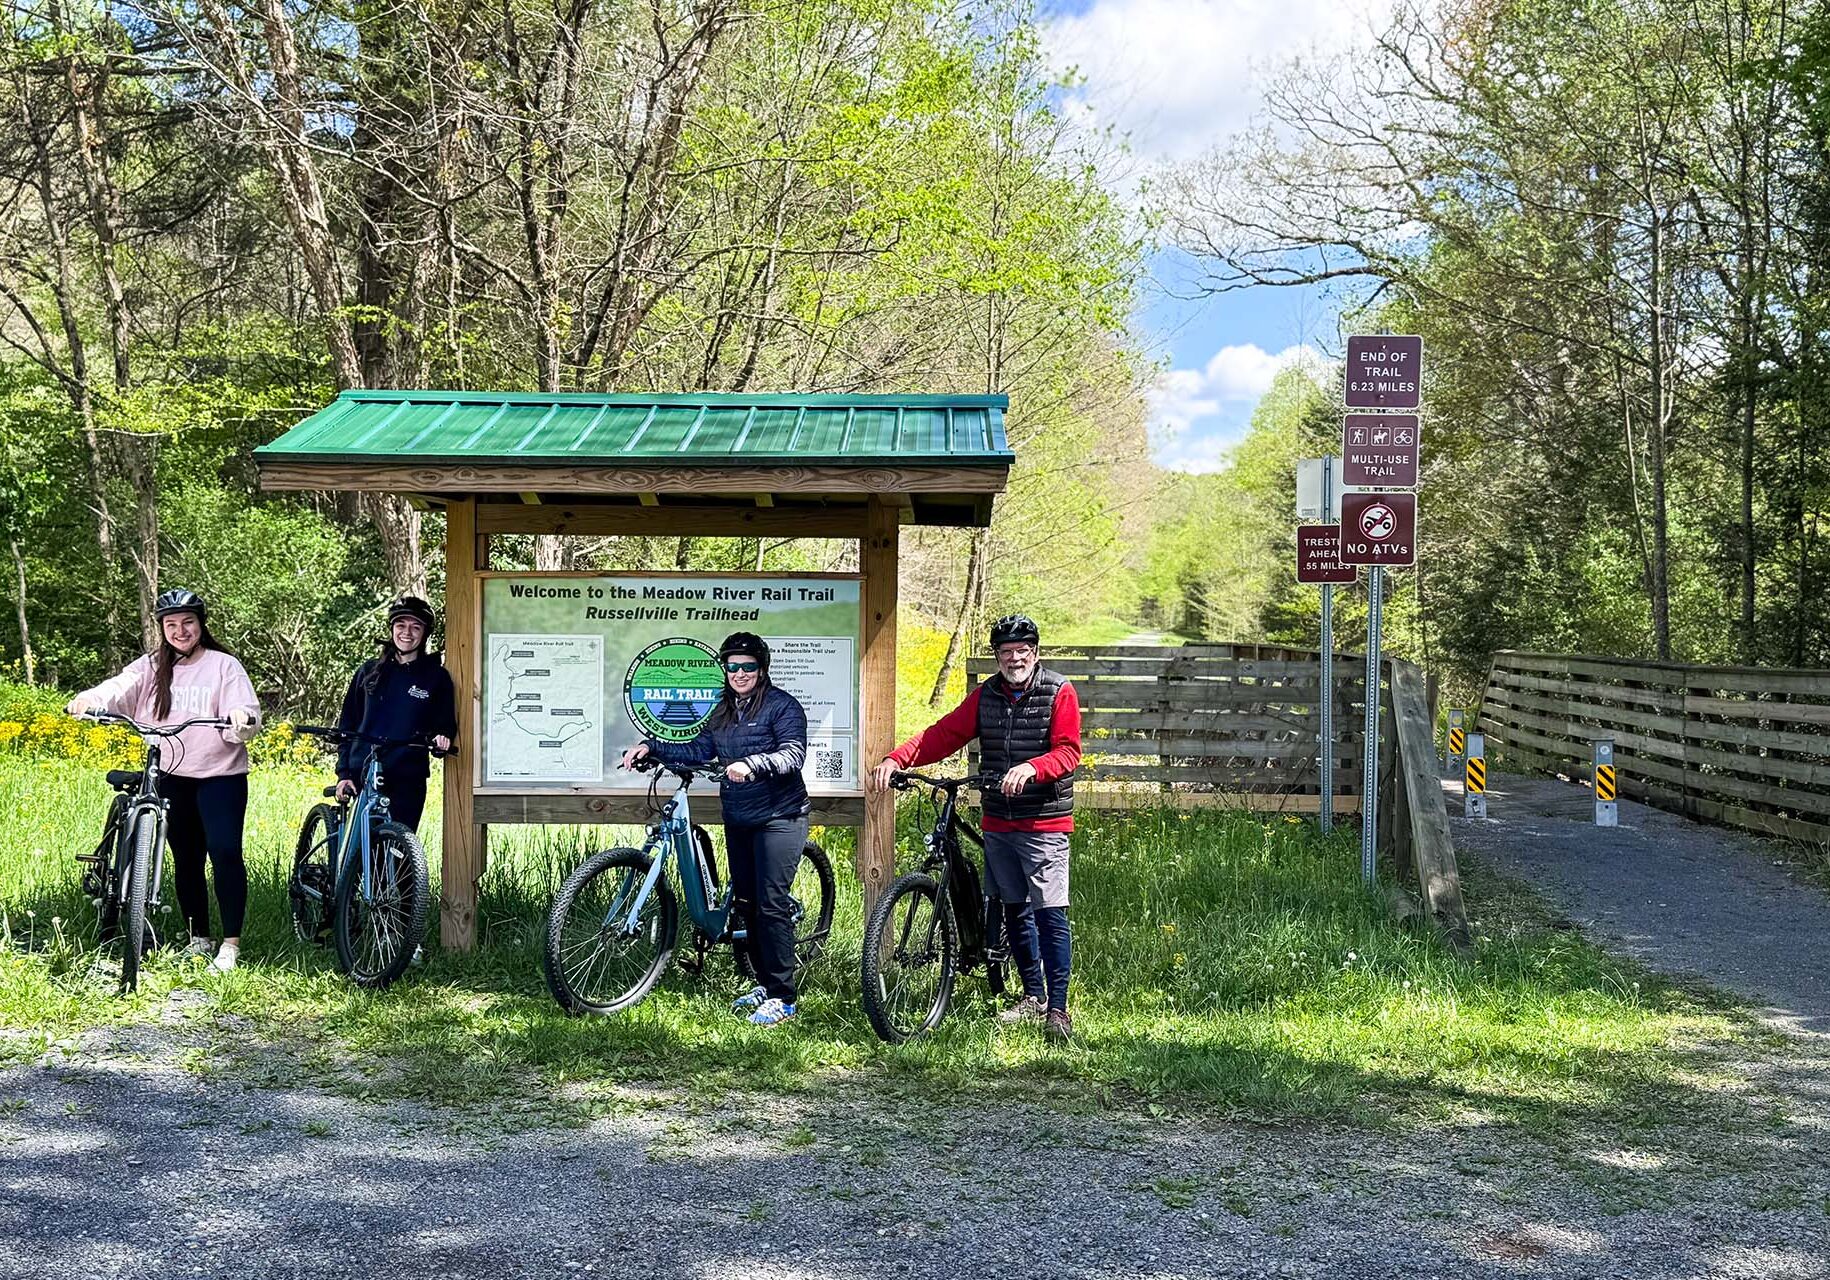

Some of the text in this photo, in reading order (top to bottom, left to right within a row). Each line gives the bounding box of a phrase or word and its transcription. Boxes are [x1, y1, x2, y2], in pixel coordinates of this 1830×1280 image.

[1360, 352, 1408, 362] END OF
[1364, 366, 1402, 377] TRAIL
[1350, 381, 1415, 392] 6.23 MILES
[1351, 454, 1410, 464] MULTI-USE
[1364, 466, 1396, 476] TRAIL
[1309, 550, 1340, 558] AHEA
[1347, 543, 1408, 554] NO ATVs
[1303, 562, 1351, 570] .55 MILES
[509, 584, 834, 601] Welcome to the Meadow River Rail Trail
[585, 606, 760, 621] Russellville Trailhead
[644, 659, 716, 668] MEADOW RIVER
[643, 688, 716, 701] RAIL TRAIL
[171, 686, 213, 717] FORD
[637, 706, 668, 735] WEST
[670, 717, 710, 738] VIRGIN
